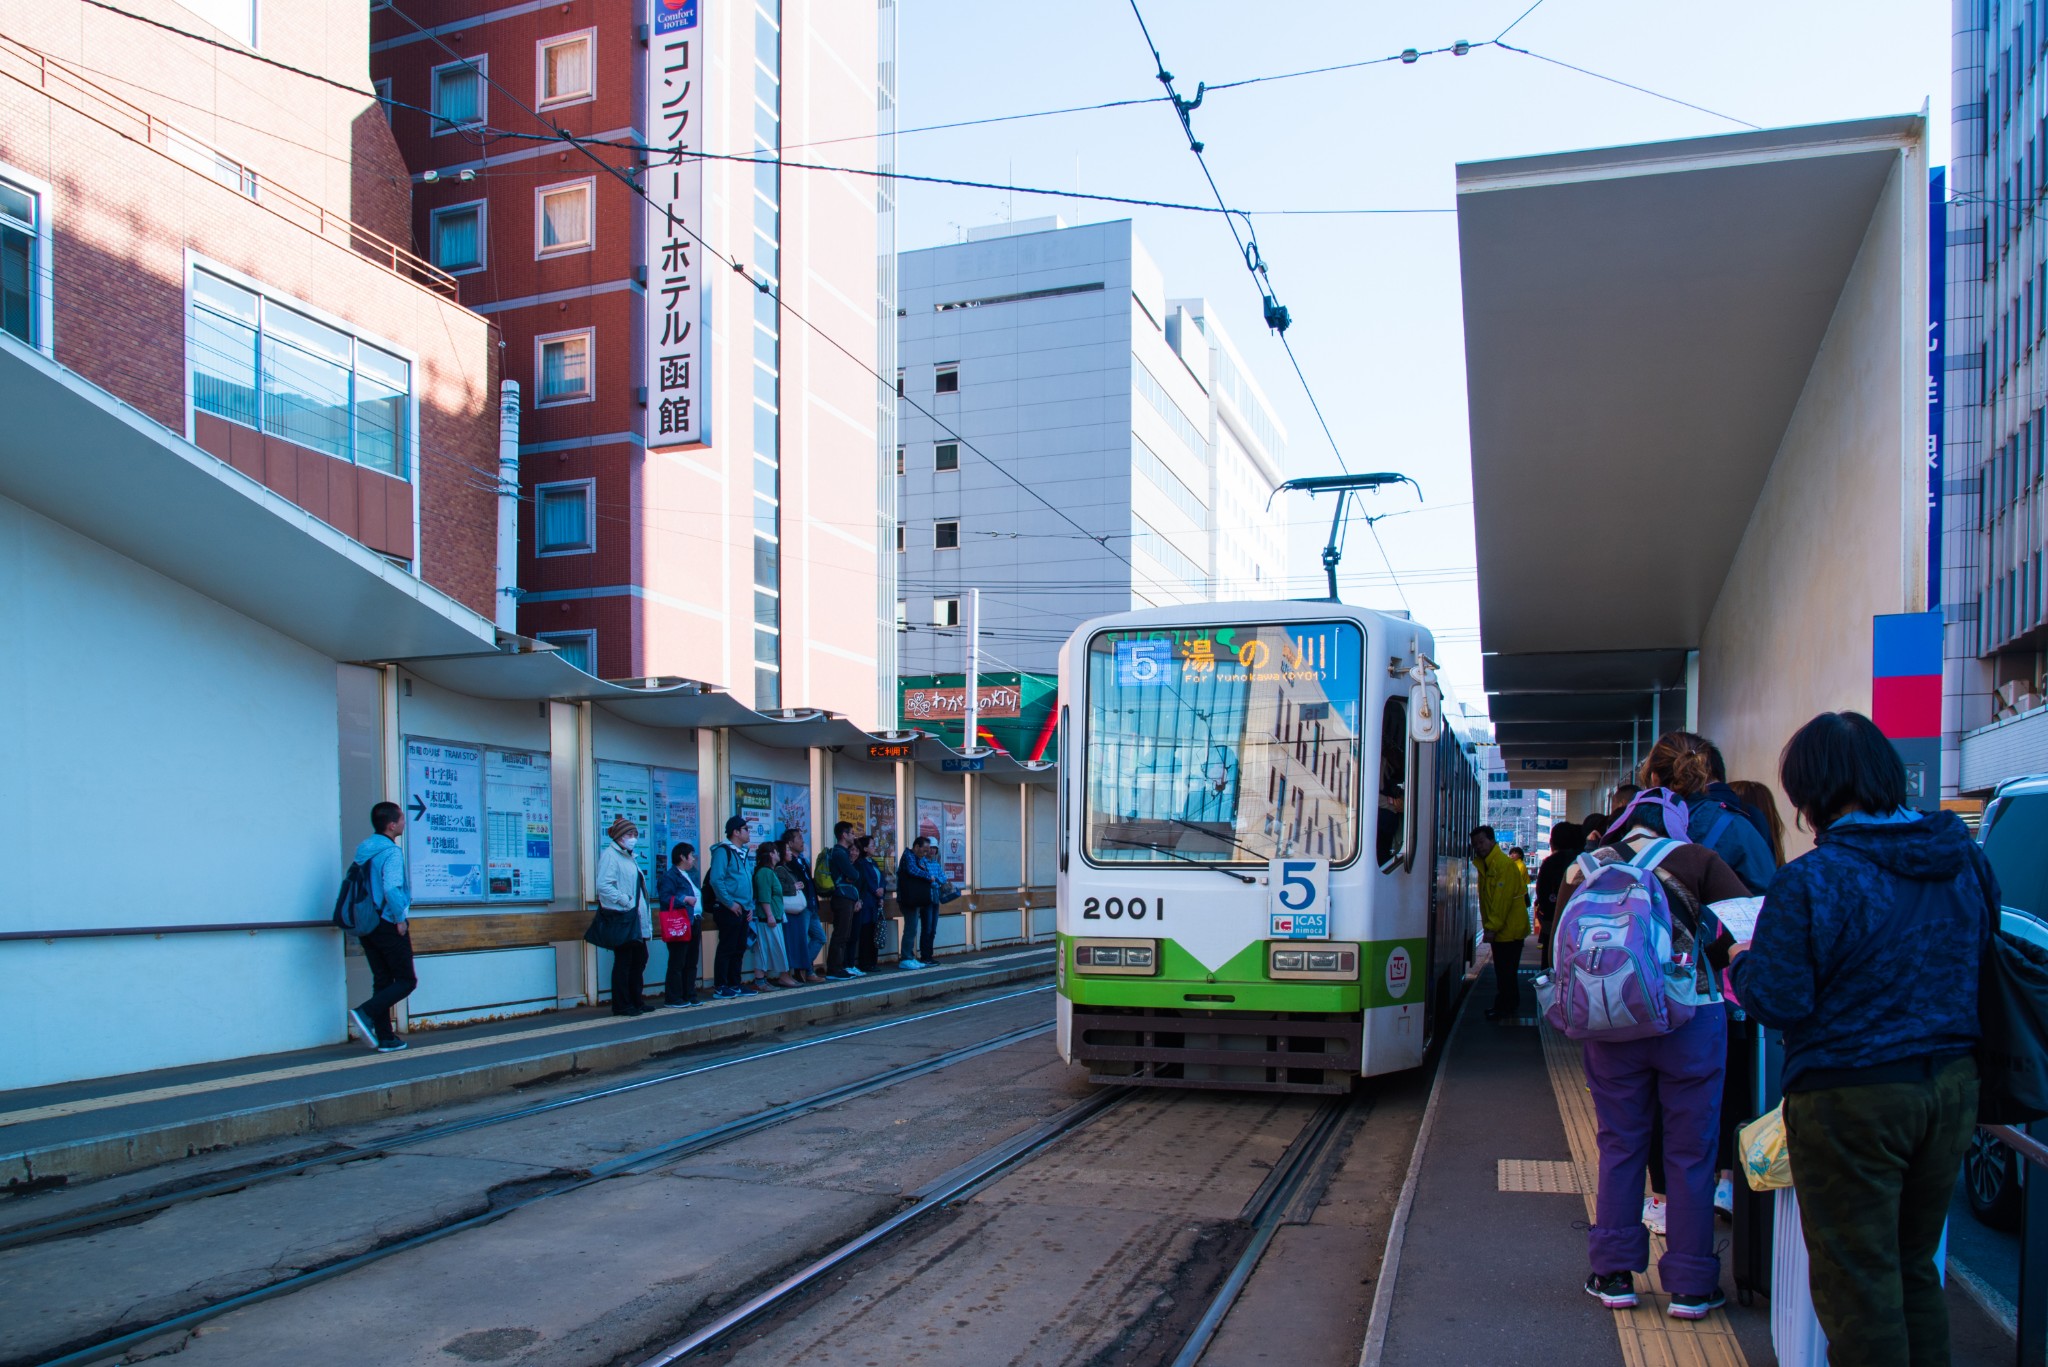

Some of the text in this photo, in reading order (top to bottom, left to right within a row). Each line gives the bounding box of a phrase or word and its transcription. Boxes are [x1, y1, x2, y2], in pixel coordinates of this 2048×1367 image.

[657, 8, 694, 24] Comfort
[663, 18, 689, 30] HOTEL
[658, 39, 691, 436] コンフォートホテル函館
[1129, 645, 1159, 681] 5
[1181, 634, 1326, 673] 湯の川
[1184, 674, 1207, 683] For
[932, 689, 1017, 712] わがの灯り
[1279, 862, 1316, 910] 5
[1083, 897, 1163, 920] 2001
[1295, 915, 1323, 926] ICAS
[1295, 926, 1323, 934] nimoca
